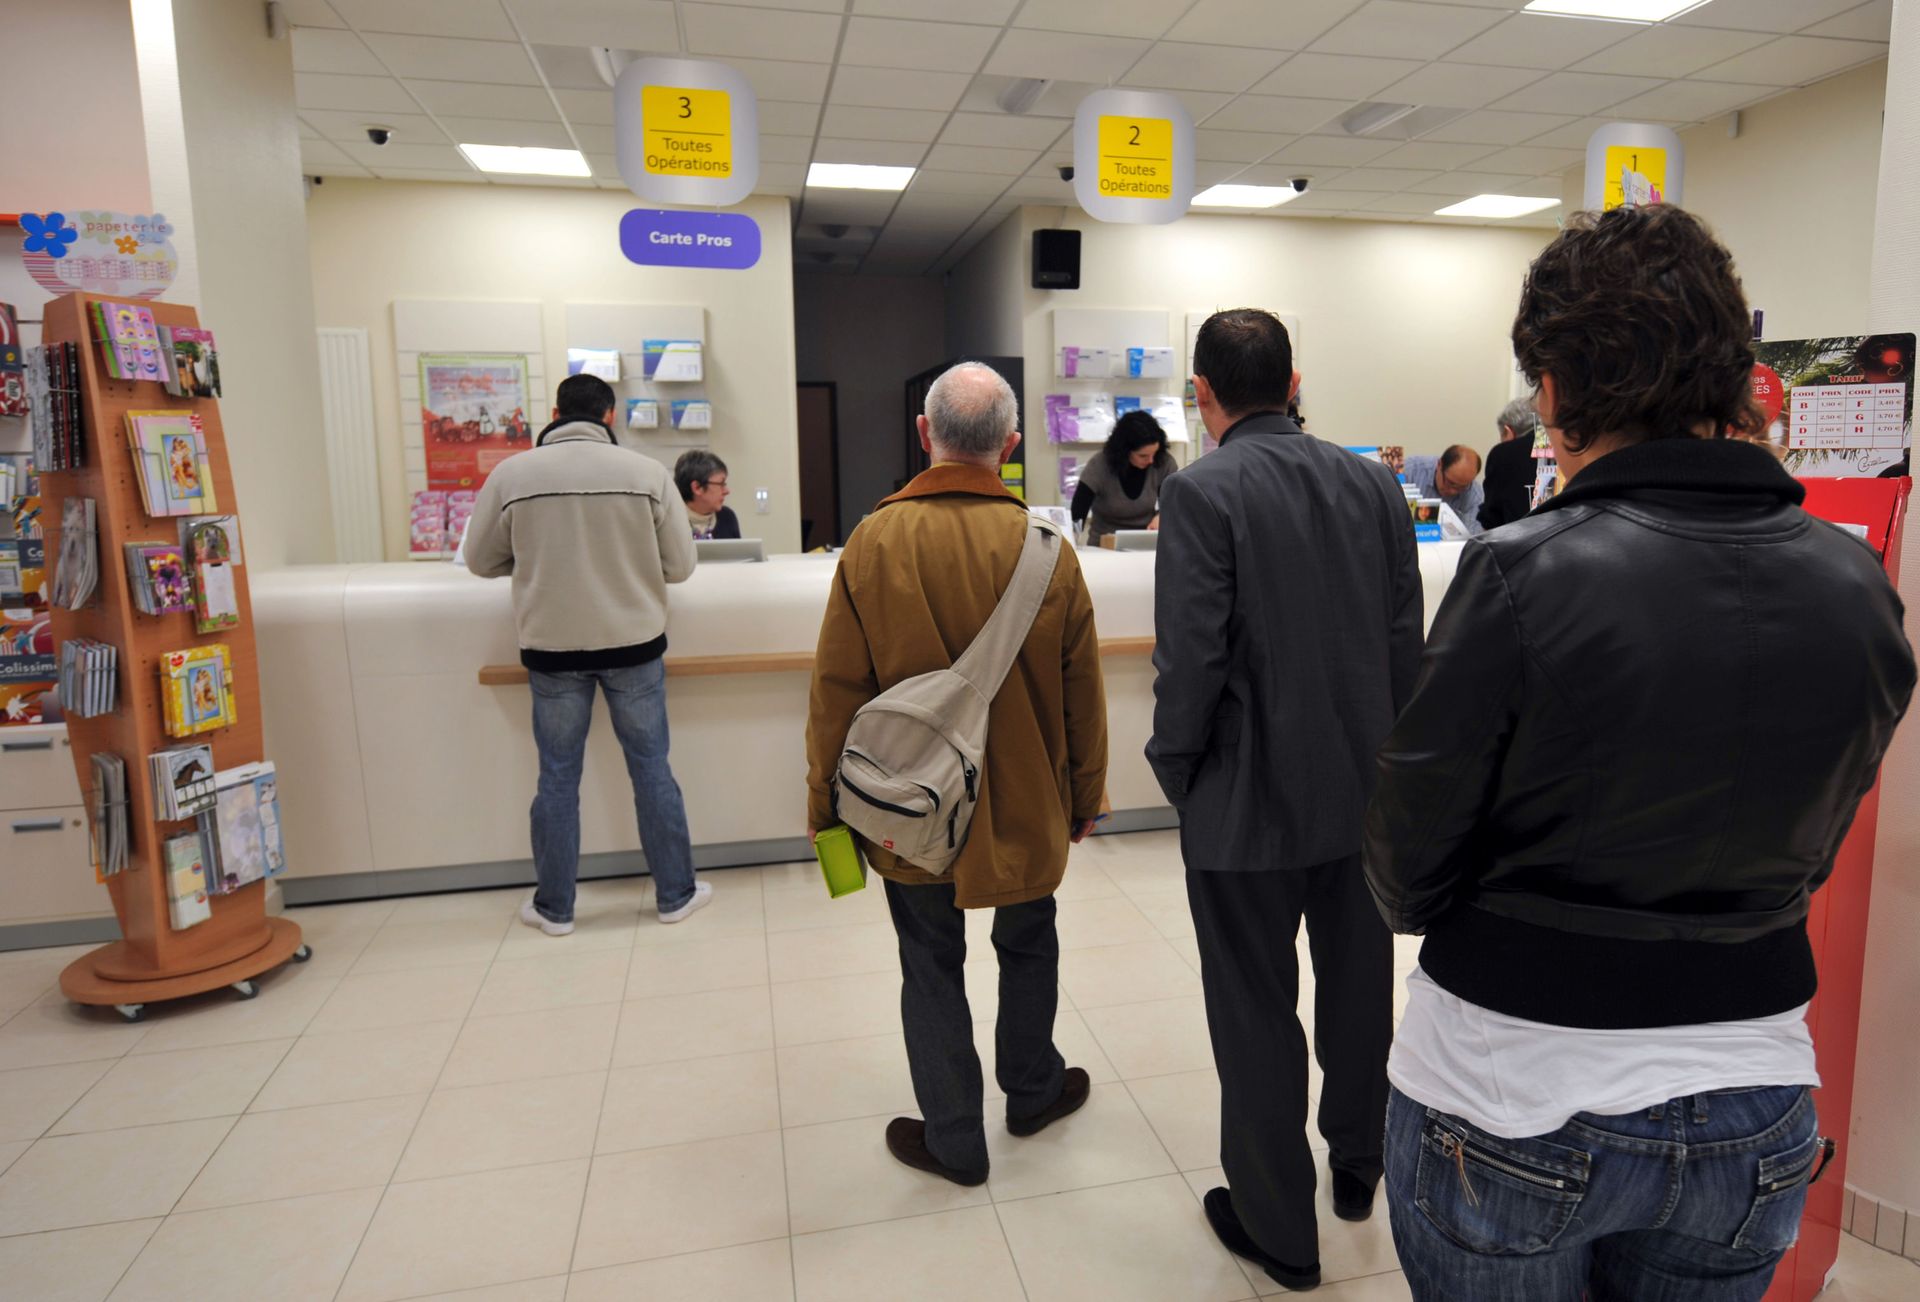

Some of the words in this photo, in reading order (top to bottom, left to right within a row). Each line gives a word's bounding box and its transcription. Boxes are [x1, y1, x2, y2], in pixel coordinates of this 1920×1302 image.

[678, 95, 692, 119] 3
[1128, 125, 1141, 146] 2
[662, 137, 713, 153] Toutes
[646, 154, 730, 172] Opérations
[1114, 162, 1157, 176] Toutes
[1631, 154, 1637, 172] 1
[1100, 178, 1170, 194] Opérations
[87, 221, 166, 233] papeterie
[649, 230, 692, 245] Carte
[696, 233, 732, 247] Pros
